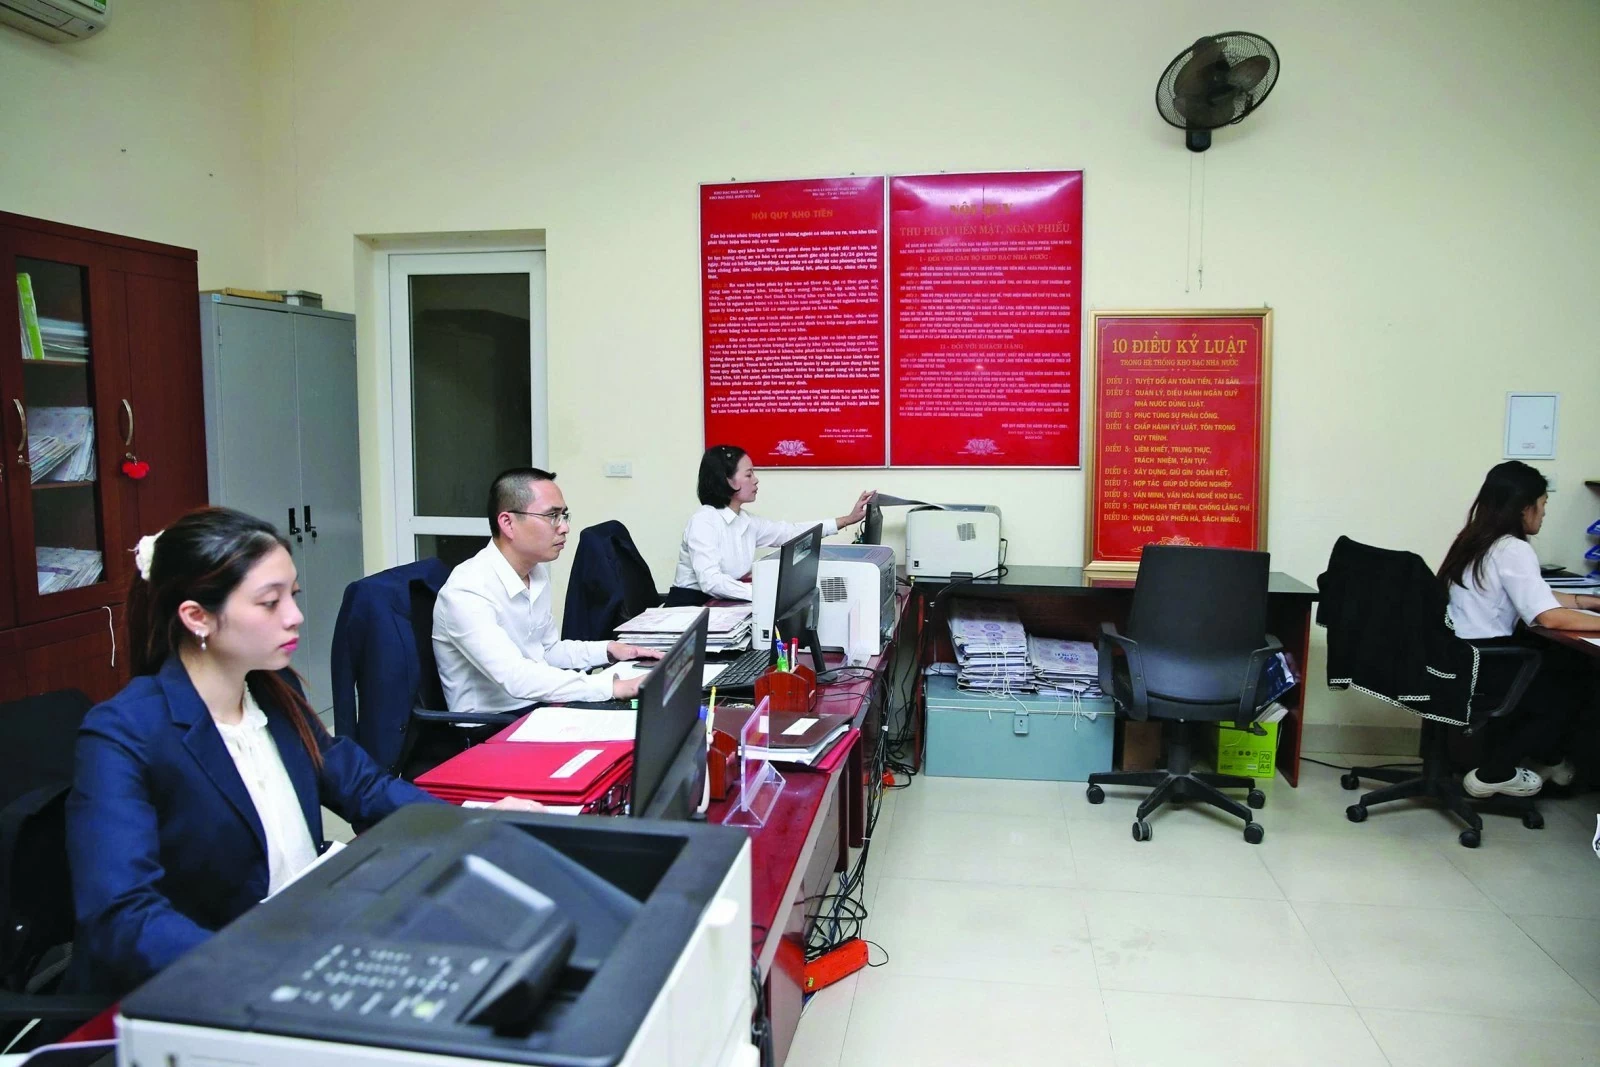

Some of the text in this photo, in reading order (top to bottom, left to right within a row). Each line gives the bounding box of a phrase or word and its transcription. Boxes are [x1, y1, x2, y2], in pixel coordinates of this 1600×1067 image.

[770, 211, 788, 220] QUY
[792, 210, 810, 219] KHO
[900, 227, 920, 236] THU
[1112, 339, 1128, 354] 10
[1176, 333, 1200, 354] KỶ
[1204, 335, 1247, 357] LUẬT
